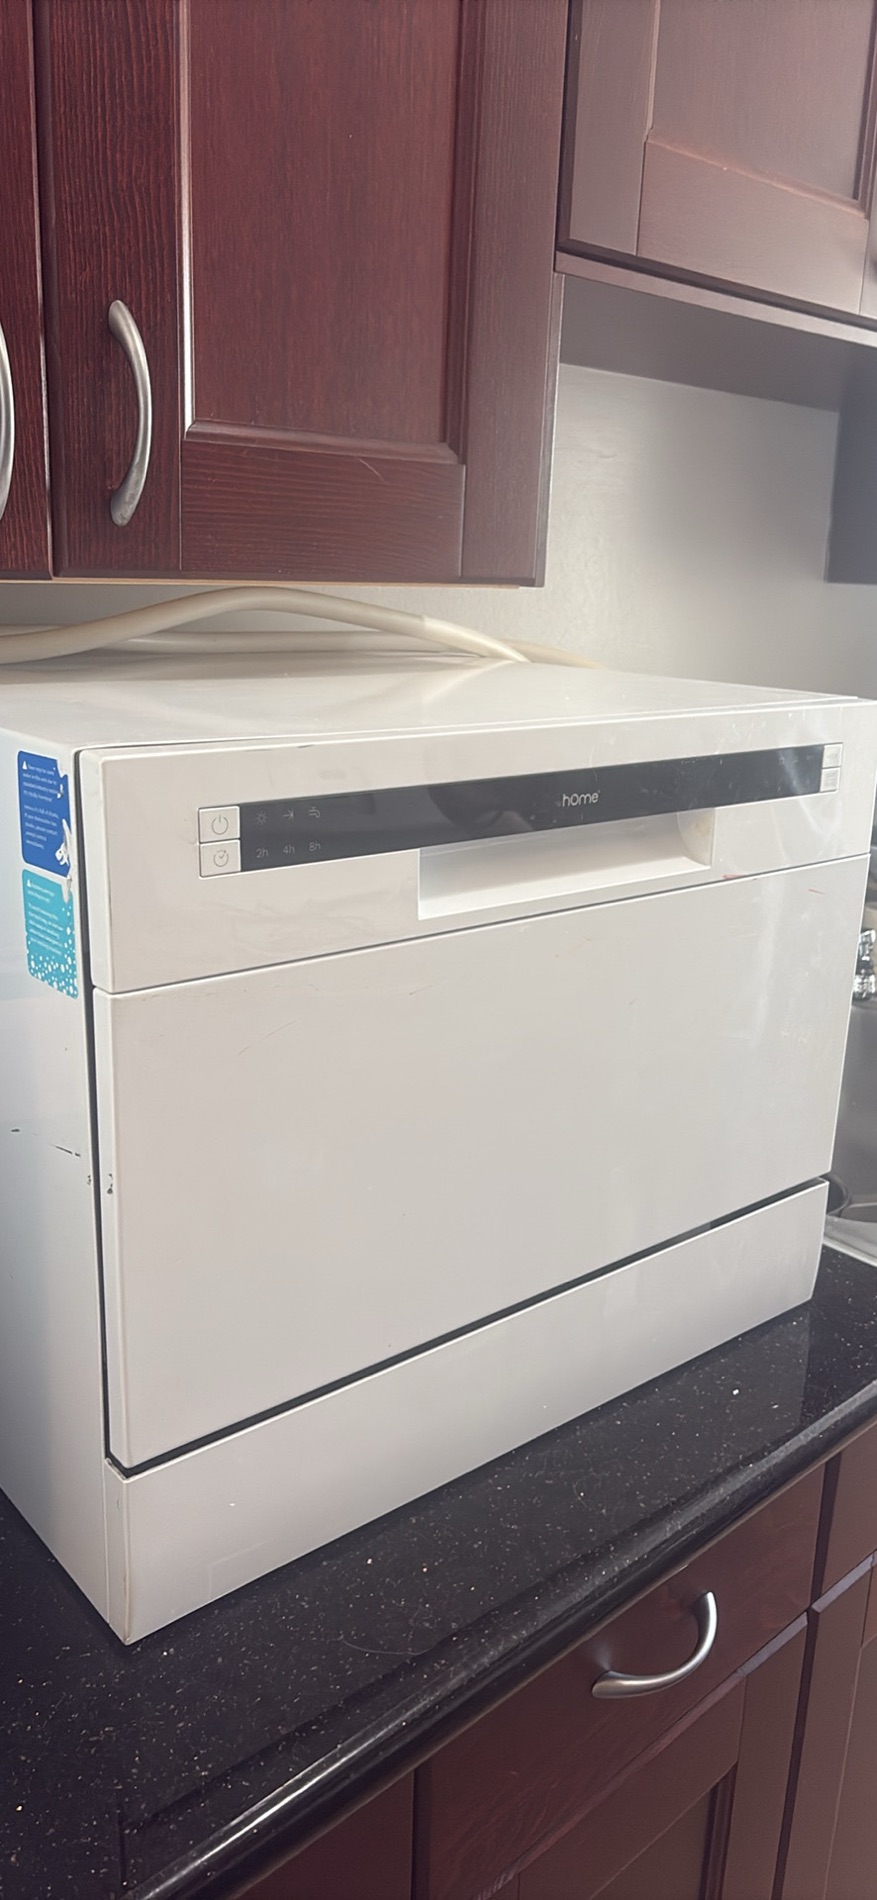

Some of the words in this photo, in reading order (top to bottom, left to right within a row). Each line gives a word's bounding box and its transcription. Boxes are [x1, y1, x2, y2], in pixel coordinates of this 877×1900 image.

[255, 847, 269, 859] 2h
[282, 844, 295, 854] 4h
[308, 841, 321, 852] 8h
